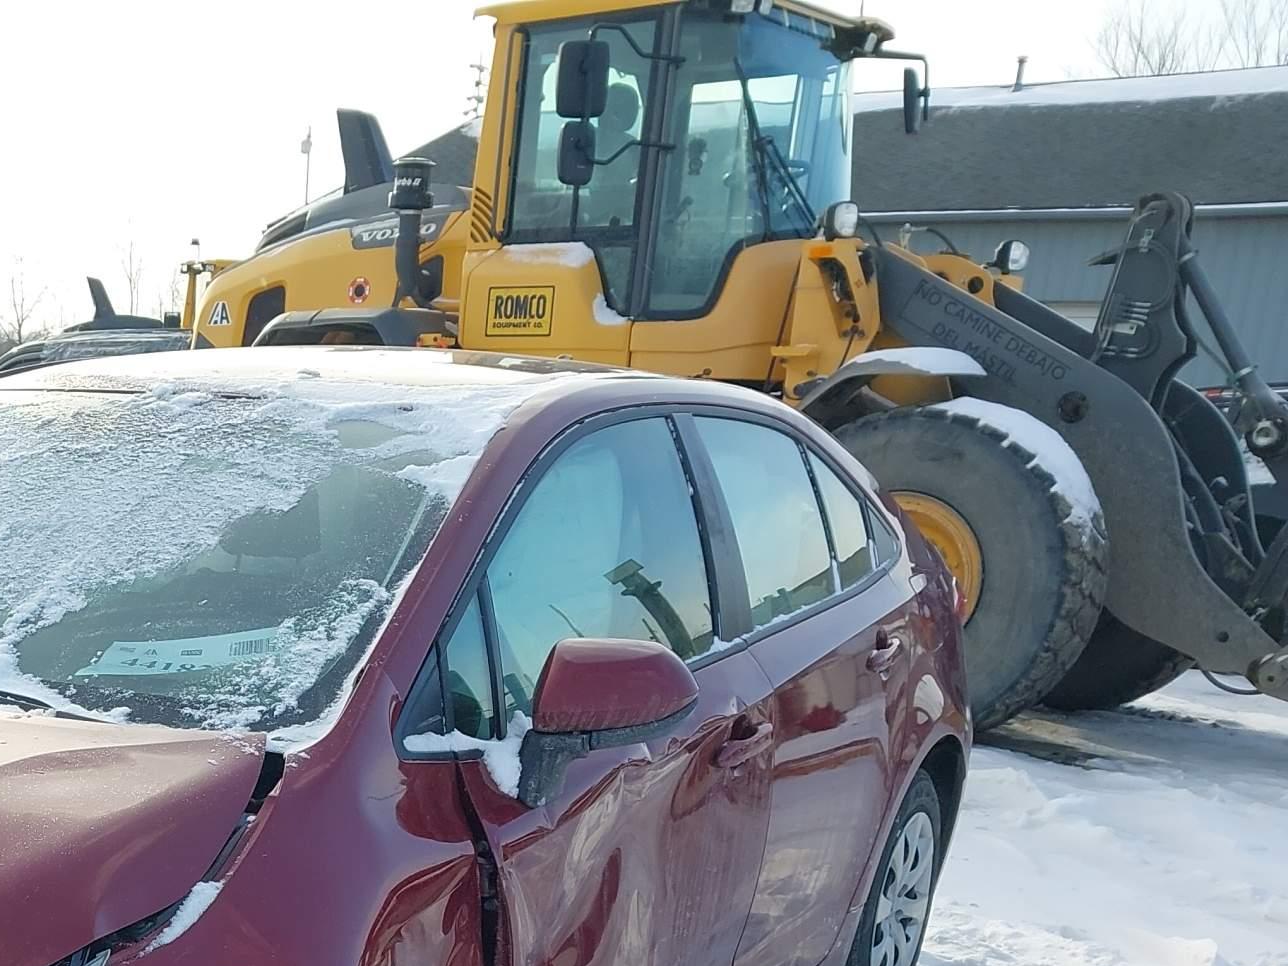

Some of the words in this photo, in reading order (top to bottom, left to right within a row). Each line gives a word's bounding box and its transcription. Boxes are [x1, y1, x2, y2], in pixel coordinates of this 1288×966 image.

[360, 223, 437, 242] VOLO
[493, 294, 547, 320] ROMCO
[492, 321, 532, 329] EQUIPMENT
[918, 282, 943, 306] NO
[944, 301, 1004, 343] CAMINE
[1004, 336, 1067, 381] DEBAJO
[931, 321, 960, 345] DEL
